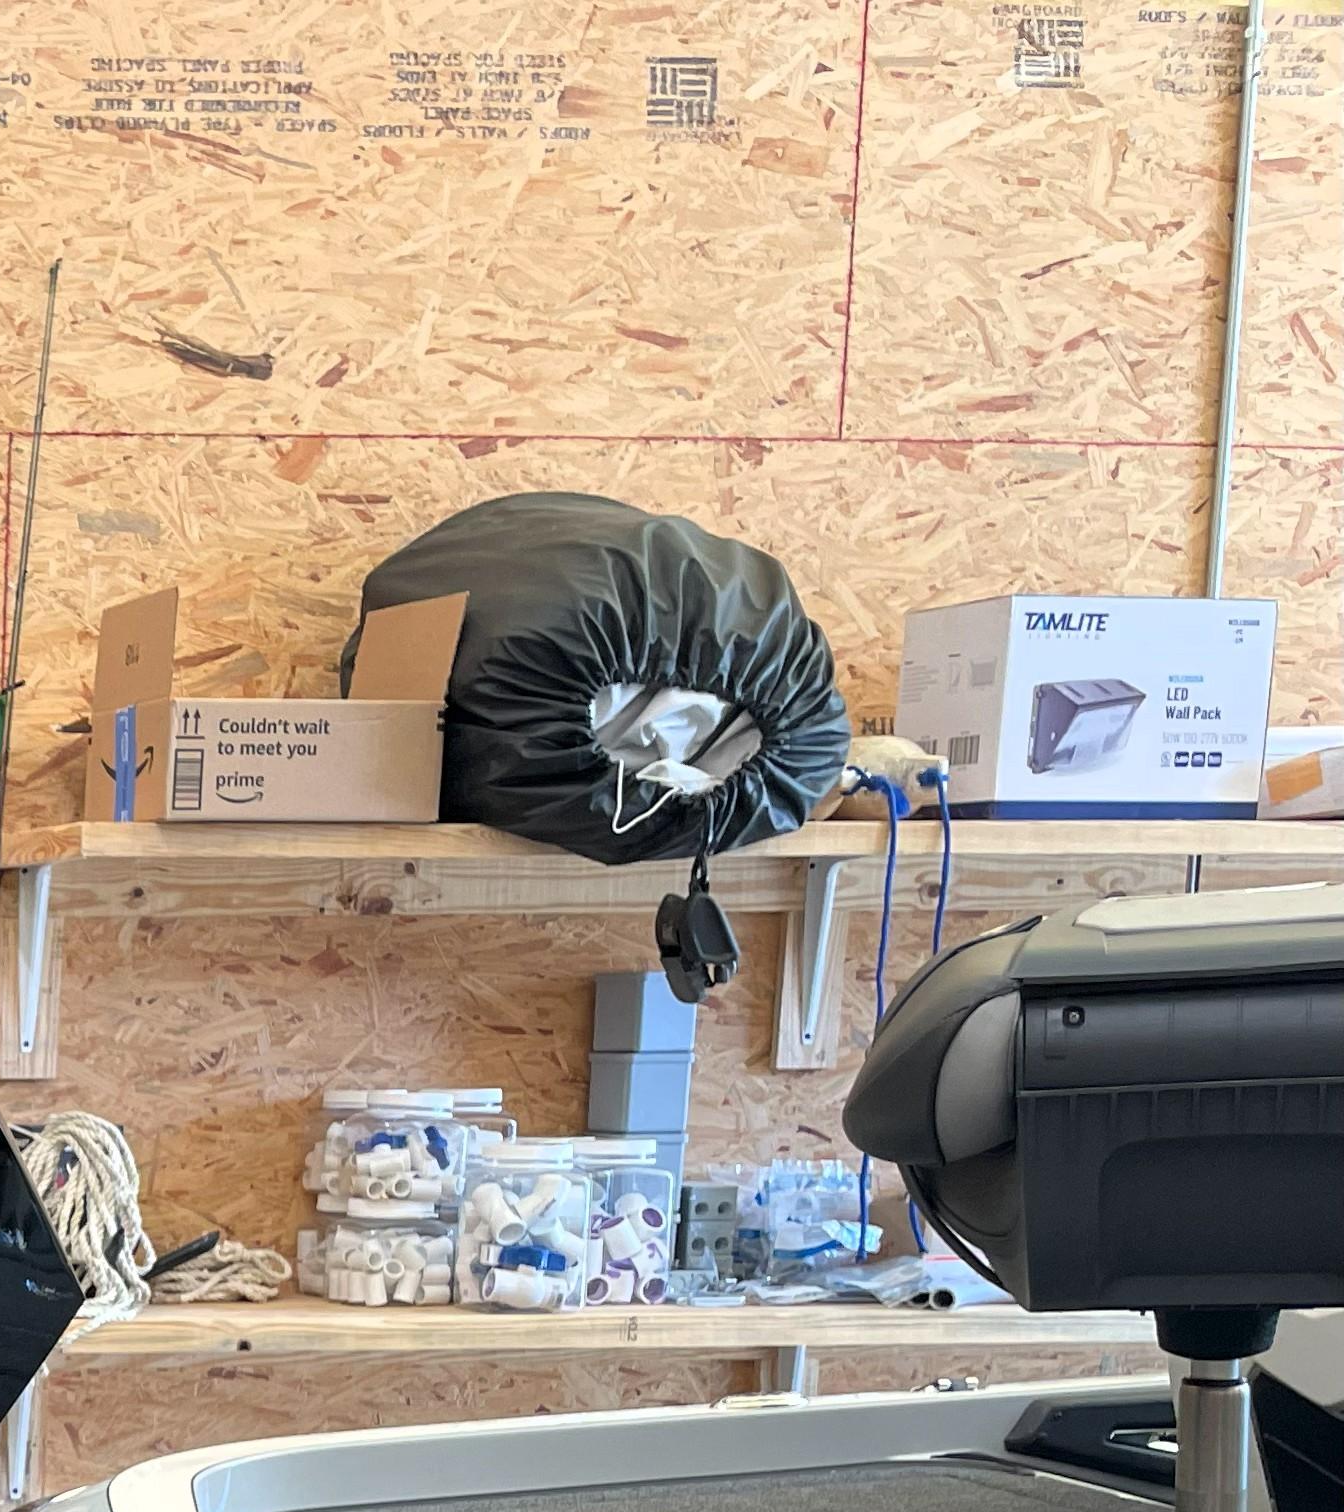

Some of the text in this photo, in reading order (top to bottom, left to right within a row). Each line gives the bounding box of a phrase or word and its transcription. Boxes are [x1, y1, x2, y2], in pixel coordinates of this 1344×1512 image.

[1138, 10, 1187, 23] ROOFS
[200, 116, 243, 135] TYPE
[274, 117, 338, 133] SPACER
[539, 124, 591, 140] ROOFS
[1024, 611, 1109, 632] TAMLITE
[1166, 687, 1189, 702] LED
[1165, 706, 1223, 721] Wall Pack
[218, 717, 331, 735] Couldn't wait
[217, 740, 318, 760] to meet you
[215, 771, 265, 791] prime
